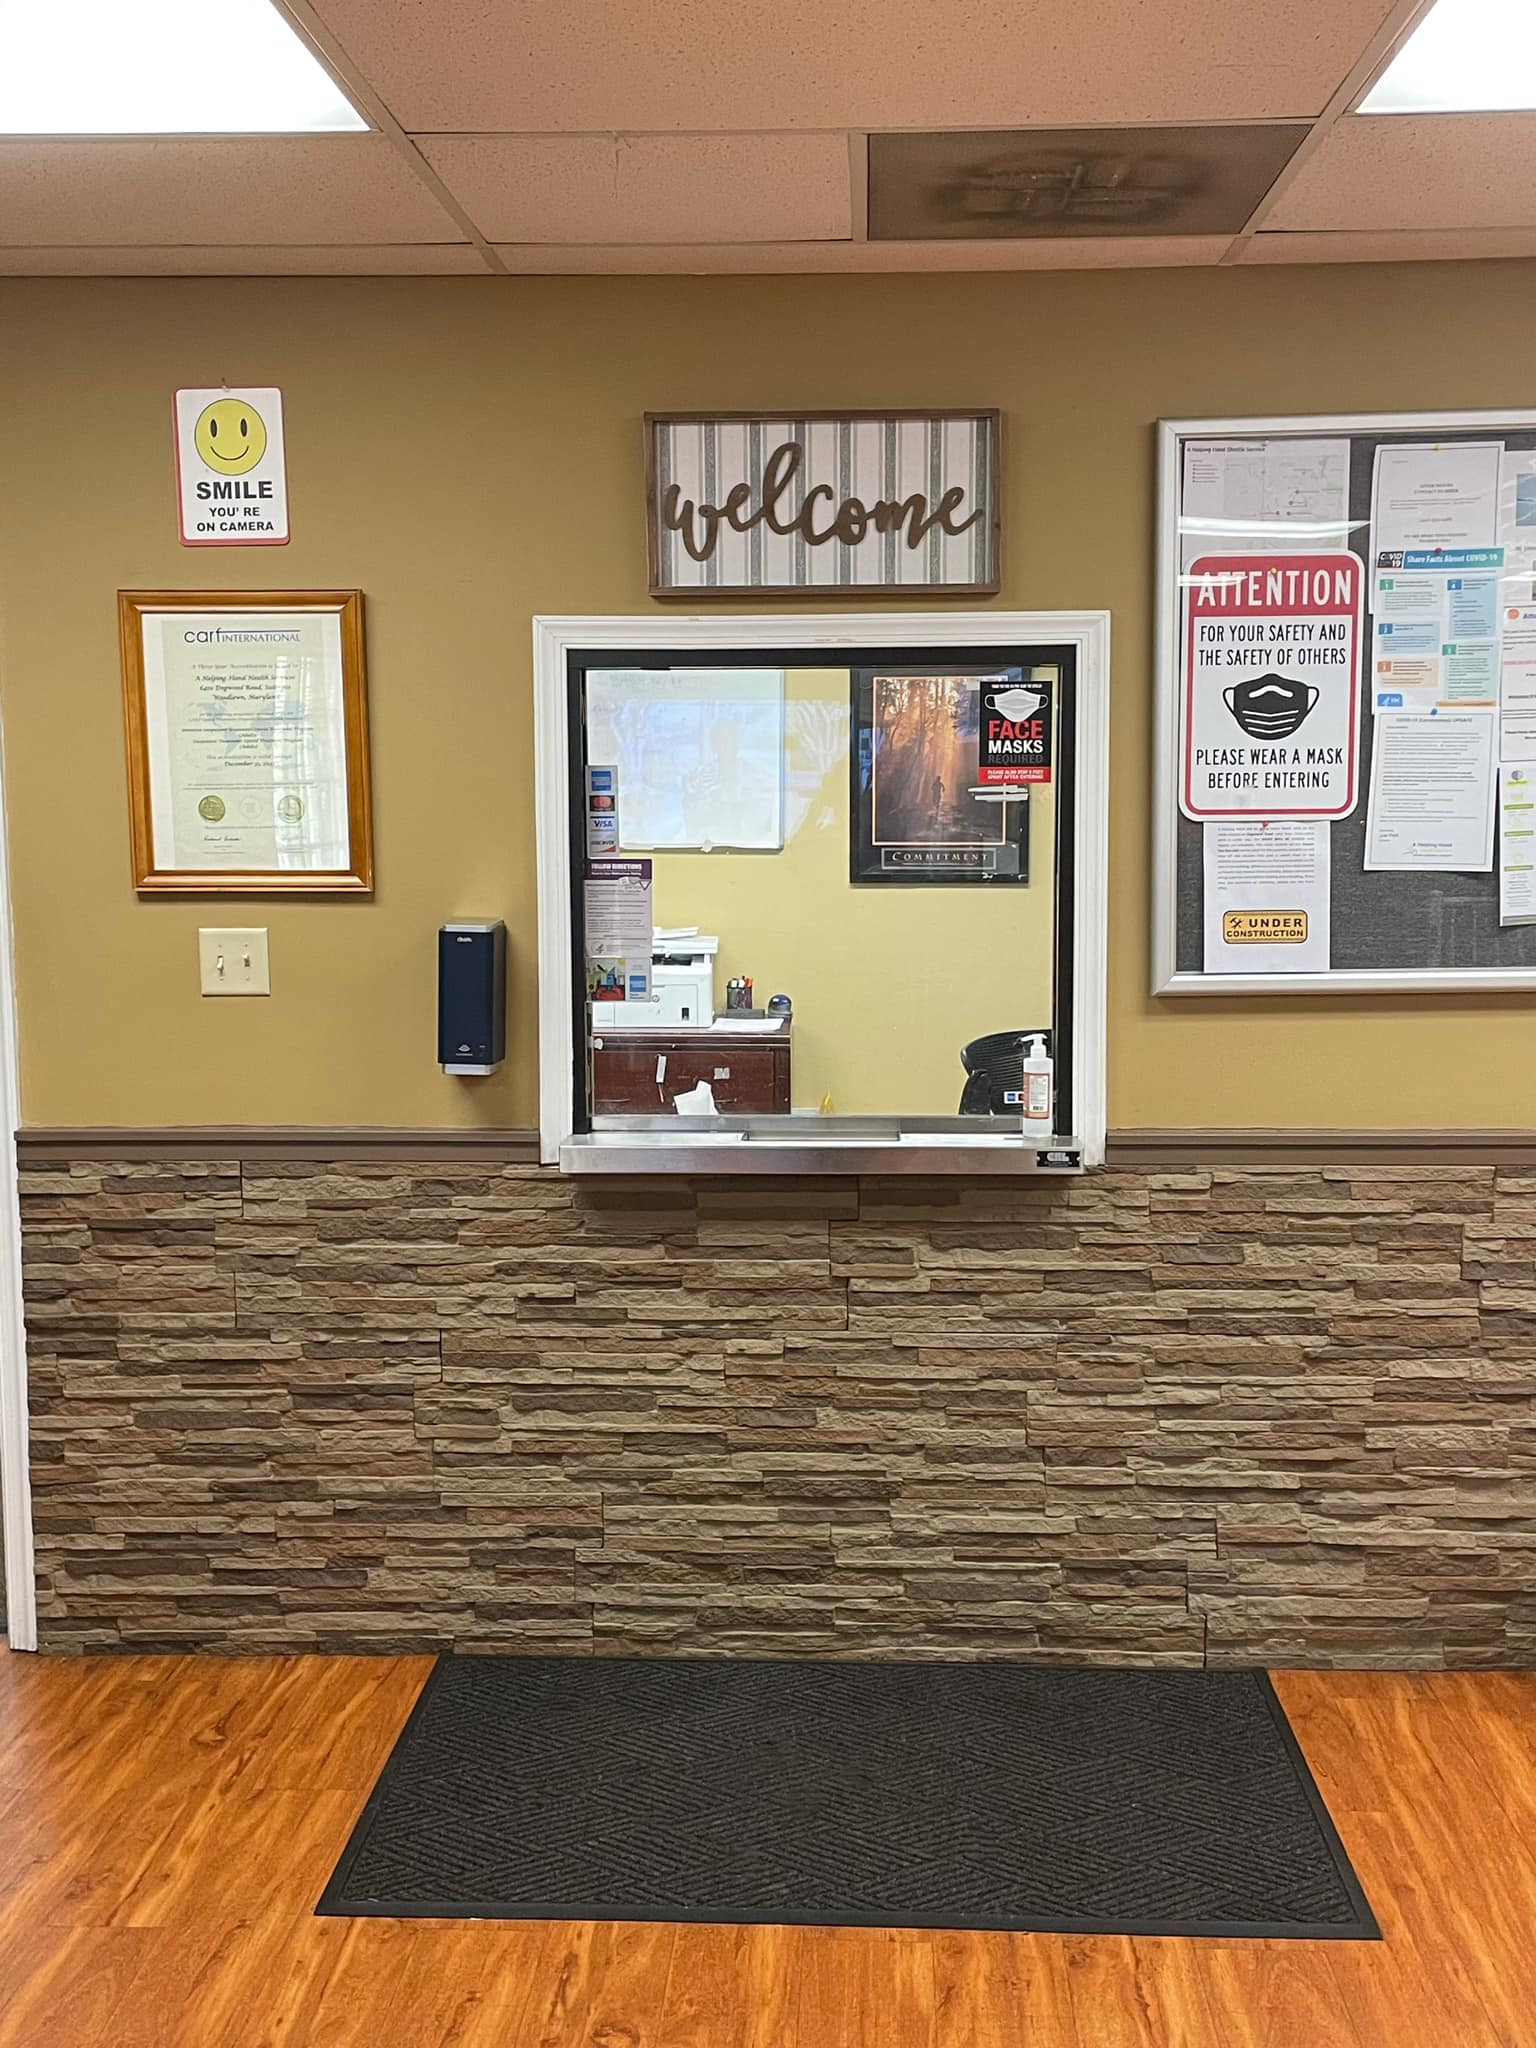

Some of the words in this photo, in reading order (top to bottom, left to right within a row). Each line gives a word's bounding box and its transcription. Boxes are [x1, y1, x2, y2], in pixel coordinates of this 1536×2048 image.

[196, 481, 273, 500] SMILE
[663, 442, 984, 562] welcome
[197, 522, 215, 532] ON
[219, 521, 274, 532] CAMERA
[1379, 553, 1402, 561] CVID
[1197, 569, 1352, 607] ATTENTION
[184, 627, 221, 643] carf
[222, 633, 301, 643] INTERNATIONAL
[1200, 625, 1224, 643] FOR
[1229, 624, 1264, 642] YOUR
[1268, 624, 1315, 642] SAFETY
[1319, 623, 1346, 641] AND
[1199, 649, 1221, 666] THE
[1226, 649, 1272, 666] SAFETY
[1277, 648, 1293, 665] OF
[1298, 648, 1346, 665] OTHERS
[988, 720, 1044, 740] FACE
[988, 739, 1044, 754] MASKS
[987, 754, 1044, 765] REQUIRED
[1196, 748, 1246, 766] PLEASE
[1250, 748, 1287, 765] WEAR
[1291, 748, 1301, 765] A
[1306, 747, 1343, 765] MASK
[1208, 772, 1259, 789] BEFORE
[1264, 771, 1330, 788] ENTERING
[891, 853, 988, 862] COMMITMENT
[1249, 918, 1303, 928] UNDER
